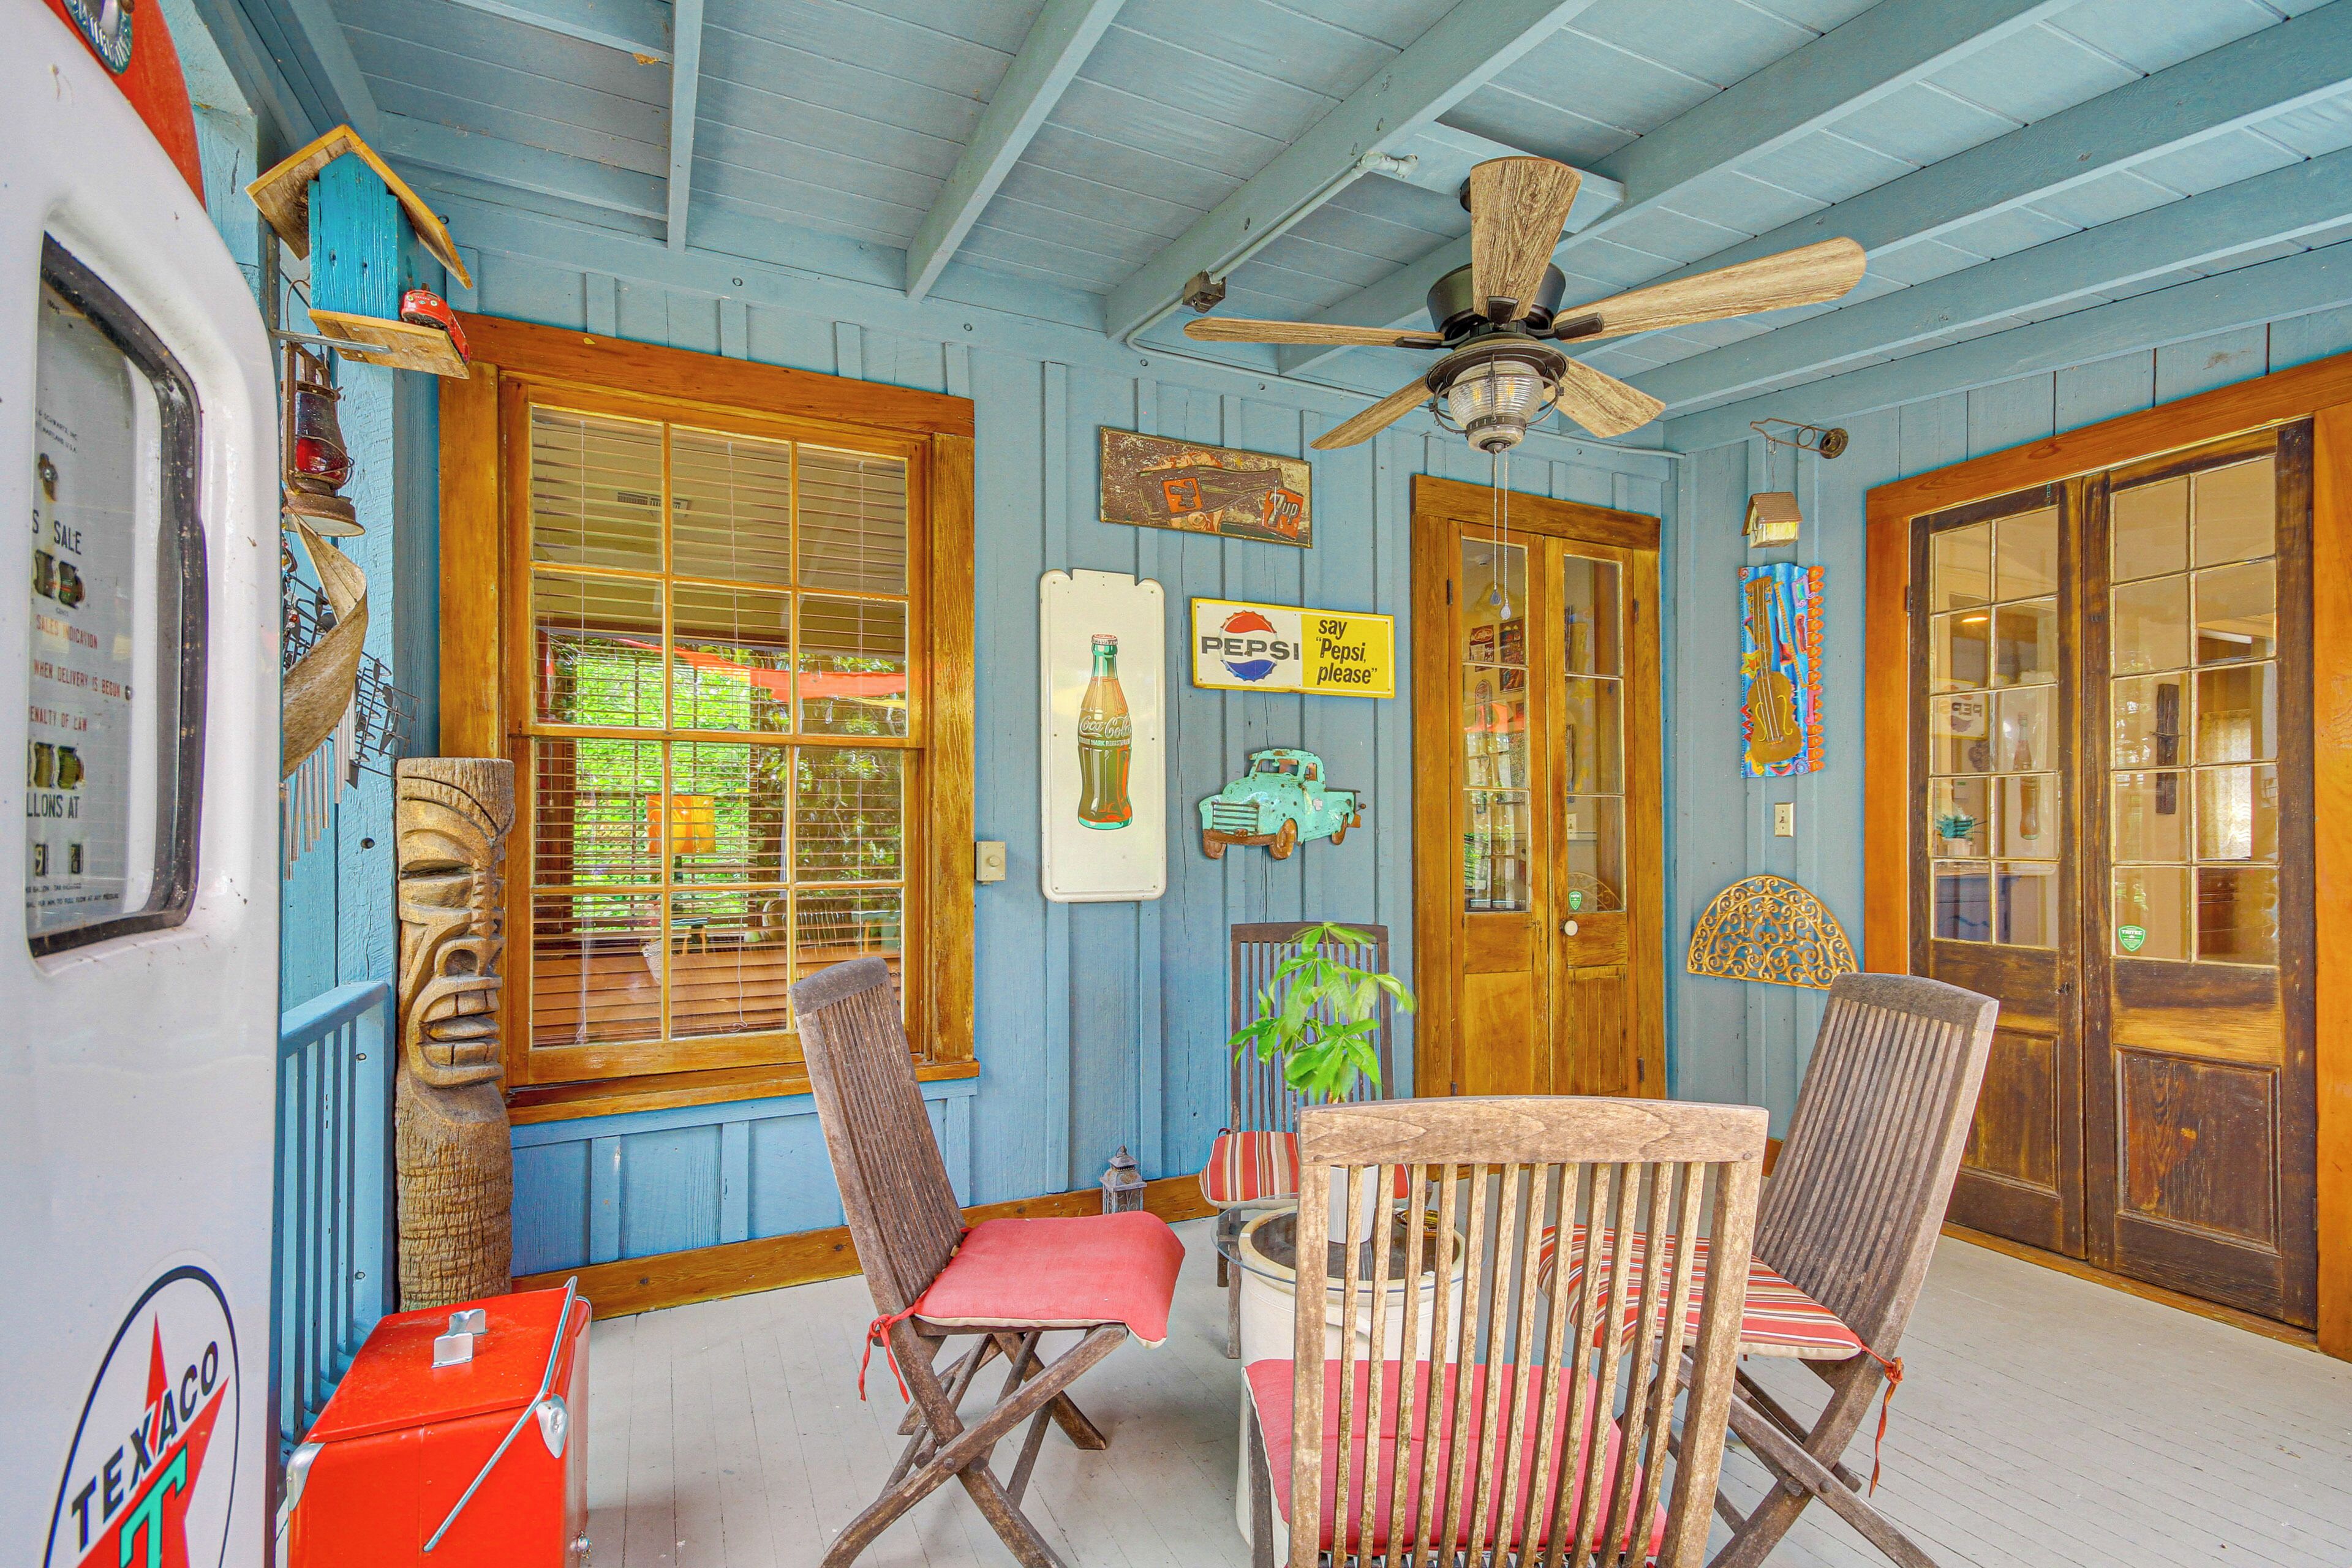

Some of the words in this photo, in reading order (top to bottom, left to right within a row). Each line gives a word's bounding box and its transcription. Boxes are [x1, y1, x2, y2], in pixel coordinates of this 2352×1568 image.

[53, 520, 82, 555] SALE
[36, 614, 59, 636] SALES
[62, 623, 98, 649] INDICATION
[1318, 619, 1348, 639] say
[1201, 636, 1299, 660] PEPSI
[34, 659, 53, 679] WHEN
[58, 666, 89, 687] DELIVERY
[92, 676, 98, 692] IS
[102, 679, 121, 698] BEGUN
[61, 712, 69, 728] OF
[74, 715, 88, 732] LAW
[68, 796, 80, 818] AT
[71, 1340, 219, 1553] TEXACO
